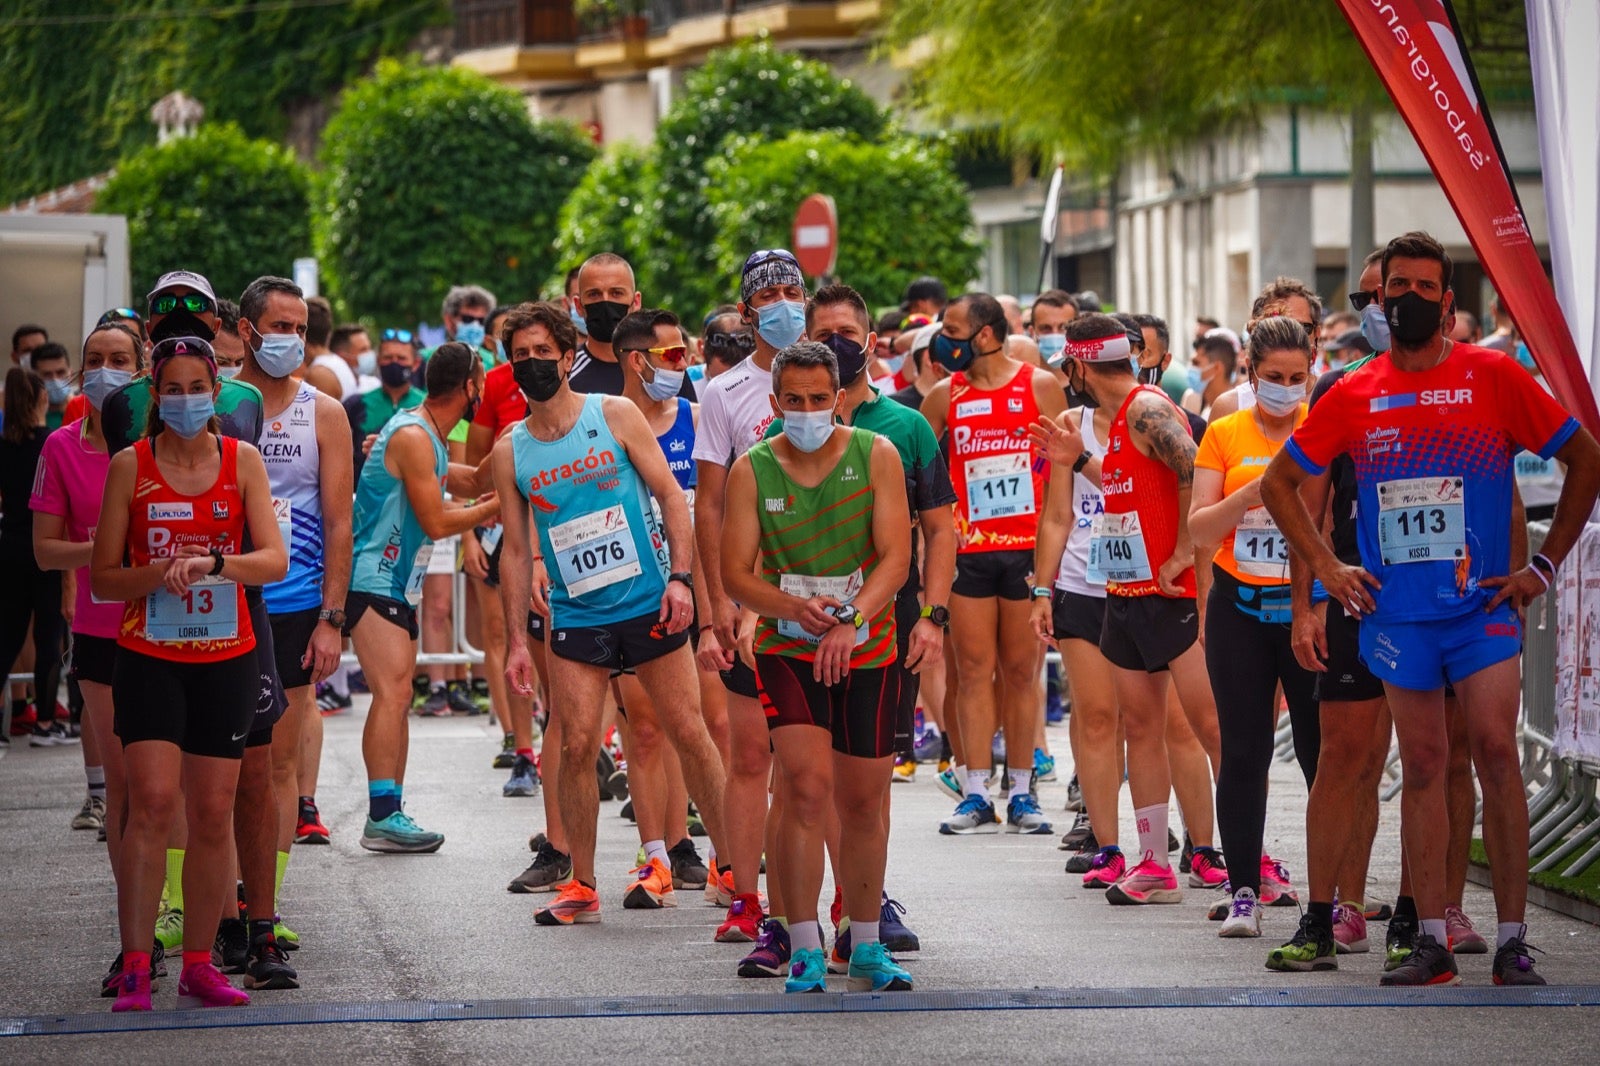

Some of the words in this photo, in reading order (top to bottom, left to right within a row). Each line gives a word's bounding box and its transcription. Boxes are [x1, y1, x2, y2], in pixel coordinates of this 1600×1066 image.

[1420, 389, 1473, 405] SEUR
[529, 446, 615, 491] atracón
[573, 466, 617, 485] running
[983, 477, 1020, 499] 117
[991, 506, 1016, 516] ANTONIO
[1398, 509, 1446, 536] 113
[571, 540, 625, 574] 1076
[1106, 540, 1132, 560] 140
[1409, 547, 1430, 559] KISCO
[181, 589, 214, 614] 13
[179, 627, 209, 638] LORENA
